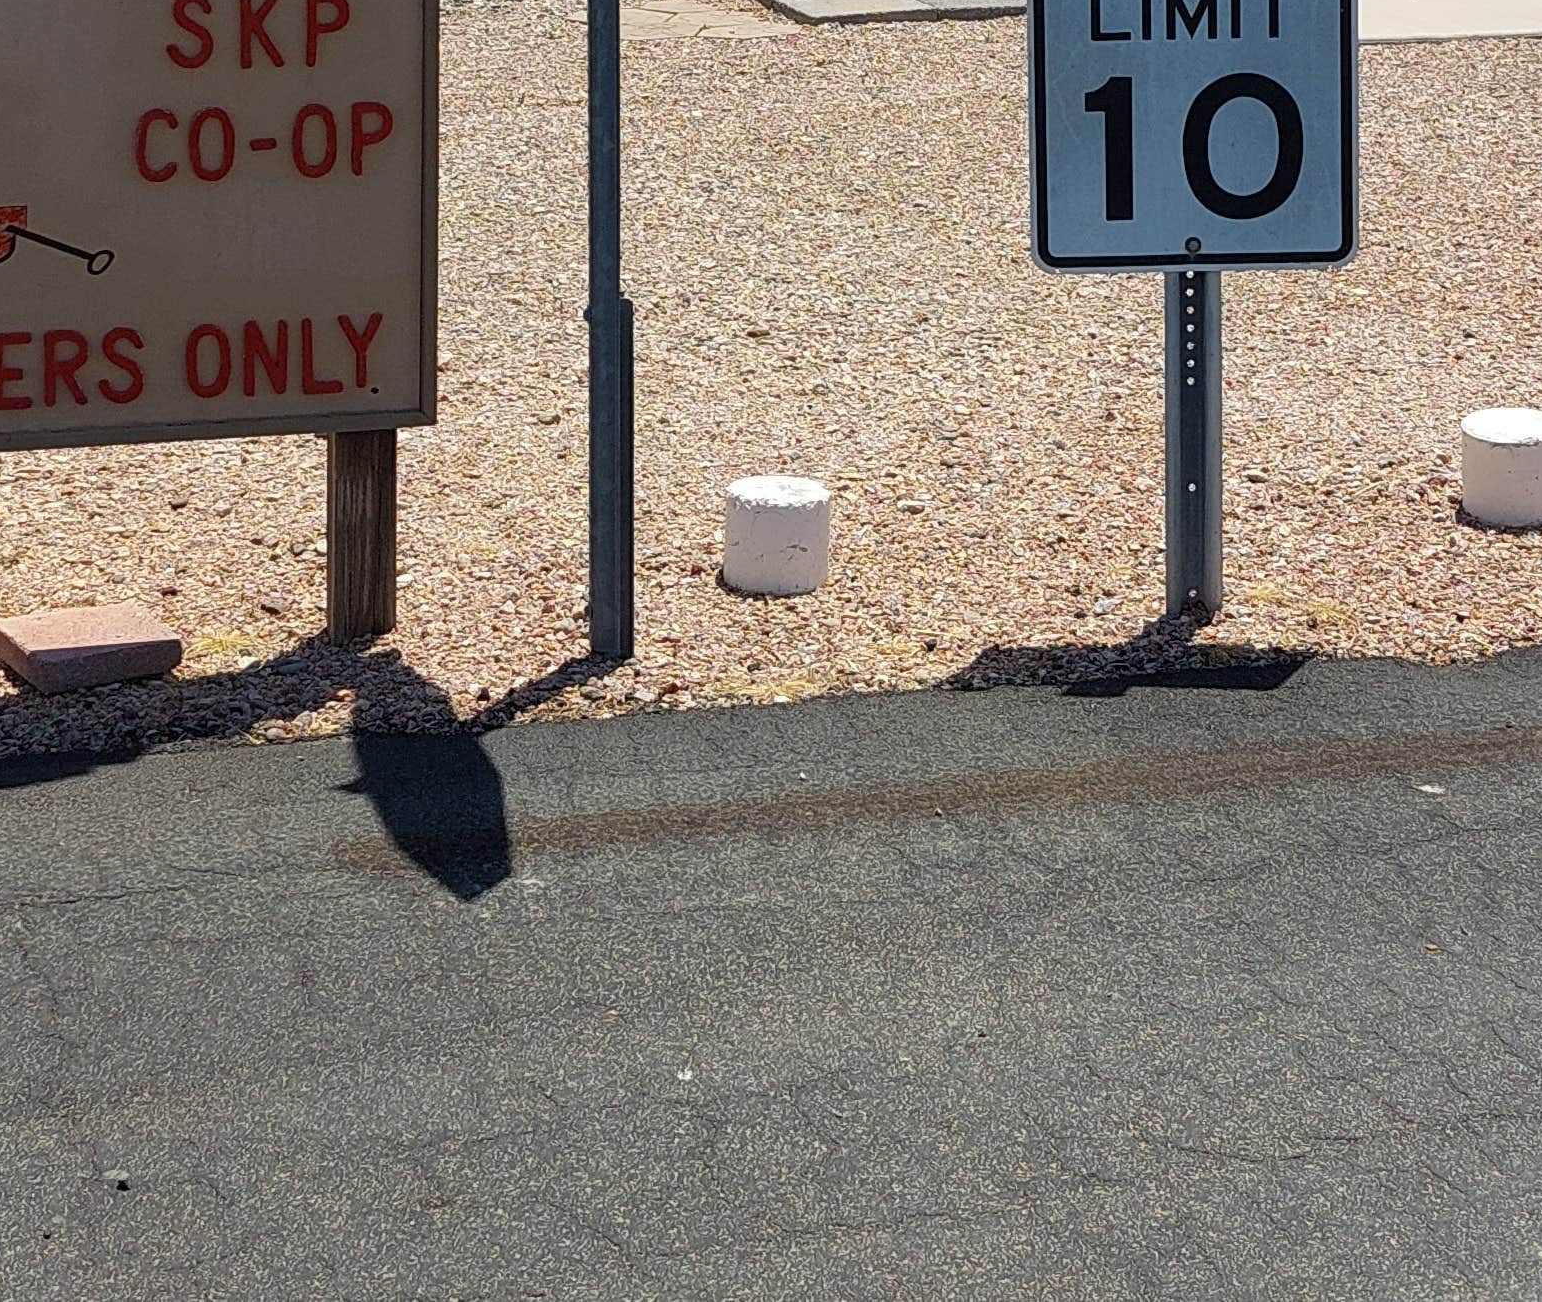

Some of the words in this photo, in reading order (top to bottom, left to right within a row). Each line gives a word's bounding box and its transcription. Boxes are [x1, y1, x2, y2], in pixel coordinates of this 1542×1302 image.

[136, 102, 393, 182] CO-OP
[1084, 72, 1304, 222] 10
[187, 313, 381, 398] ONLY
